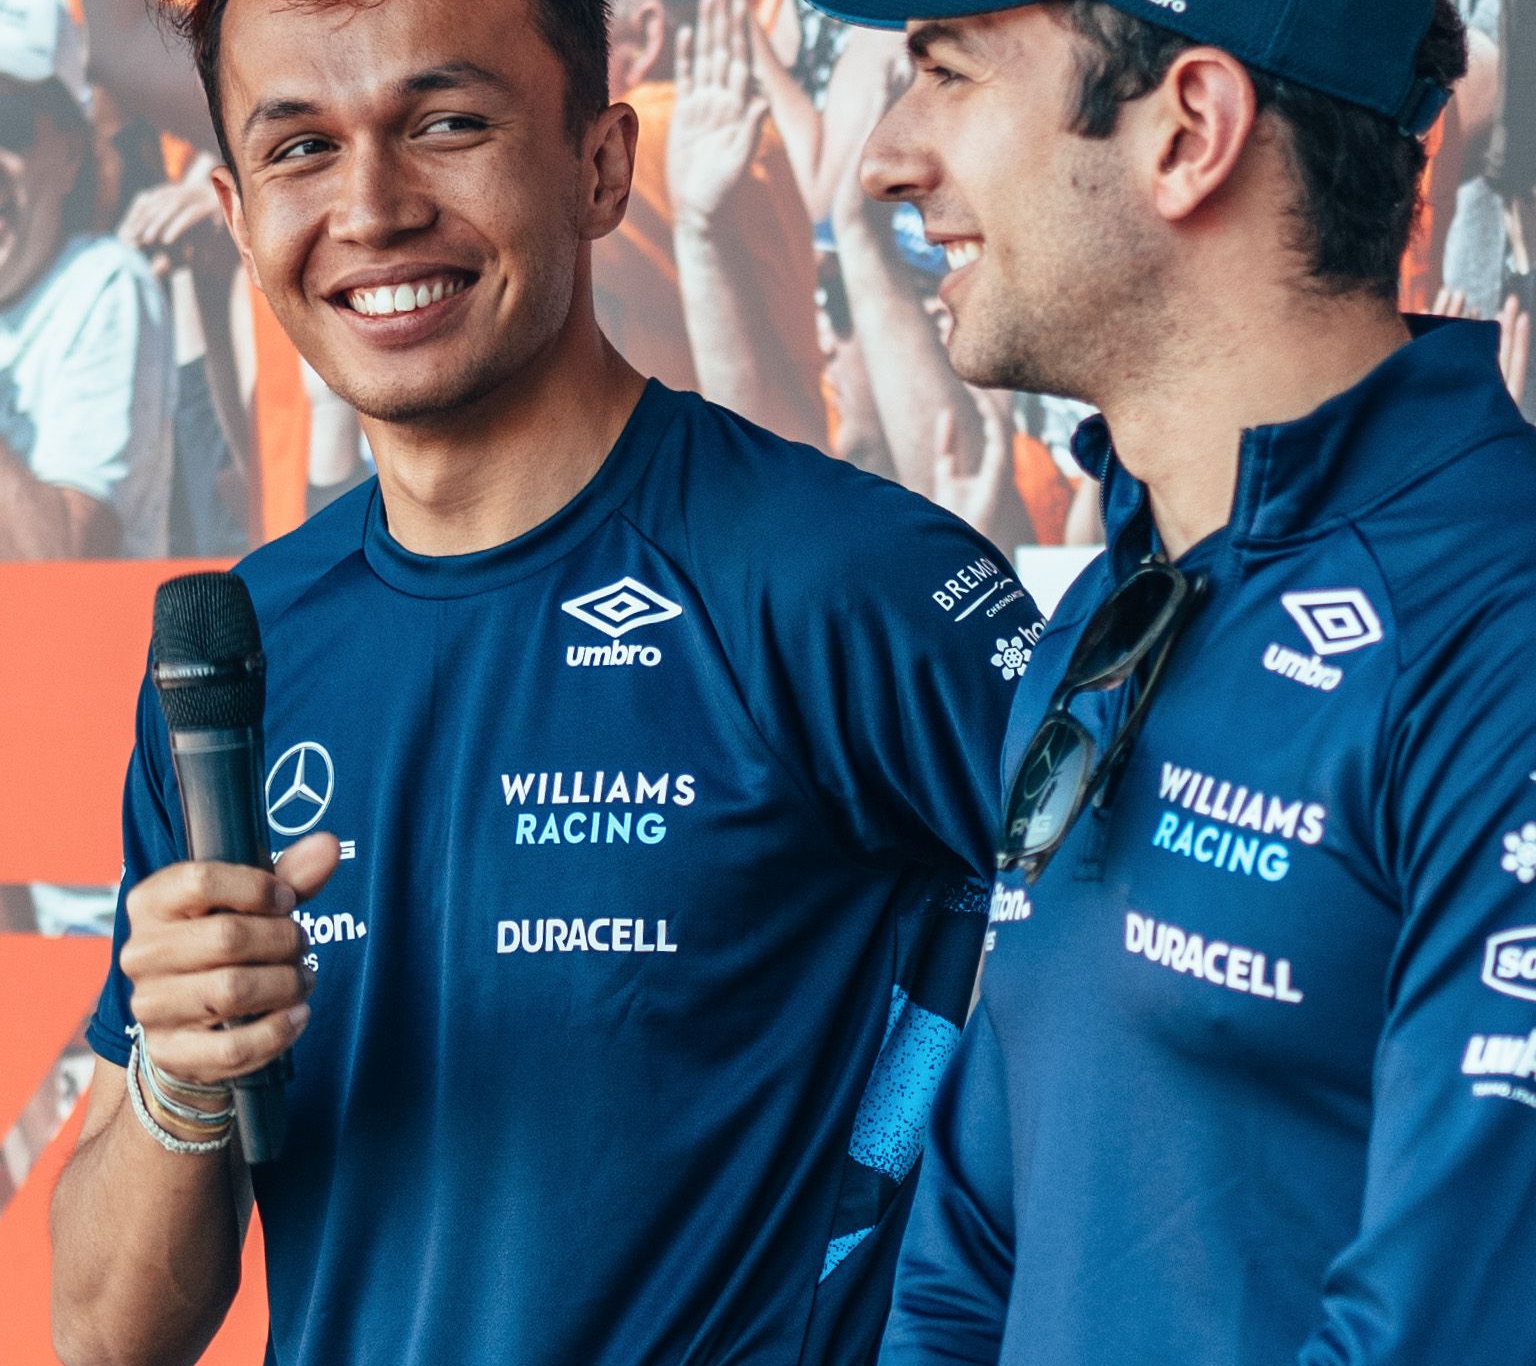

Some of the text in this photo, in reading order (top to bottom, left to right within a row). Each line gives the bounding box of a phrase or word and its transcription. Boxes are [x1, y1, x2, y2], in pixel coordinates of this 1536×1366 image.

[566, 639, 662, 667] umbro
[1263, 642, 1343, 691] umbro
[501, 770, 696, 807] WILLIAMS
[1158, 762, 1326, 845] WILLIAMS
[515, 811, 667, 845] RACING
[1152, 810, 1290, 882] RACING
[497, 918, 678, 953] DURACELL
[1125, 911, 1304, 1004] DURACELL
